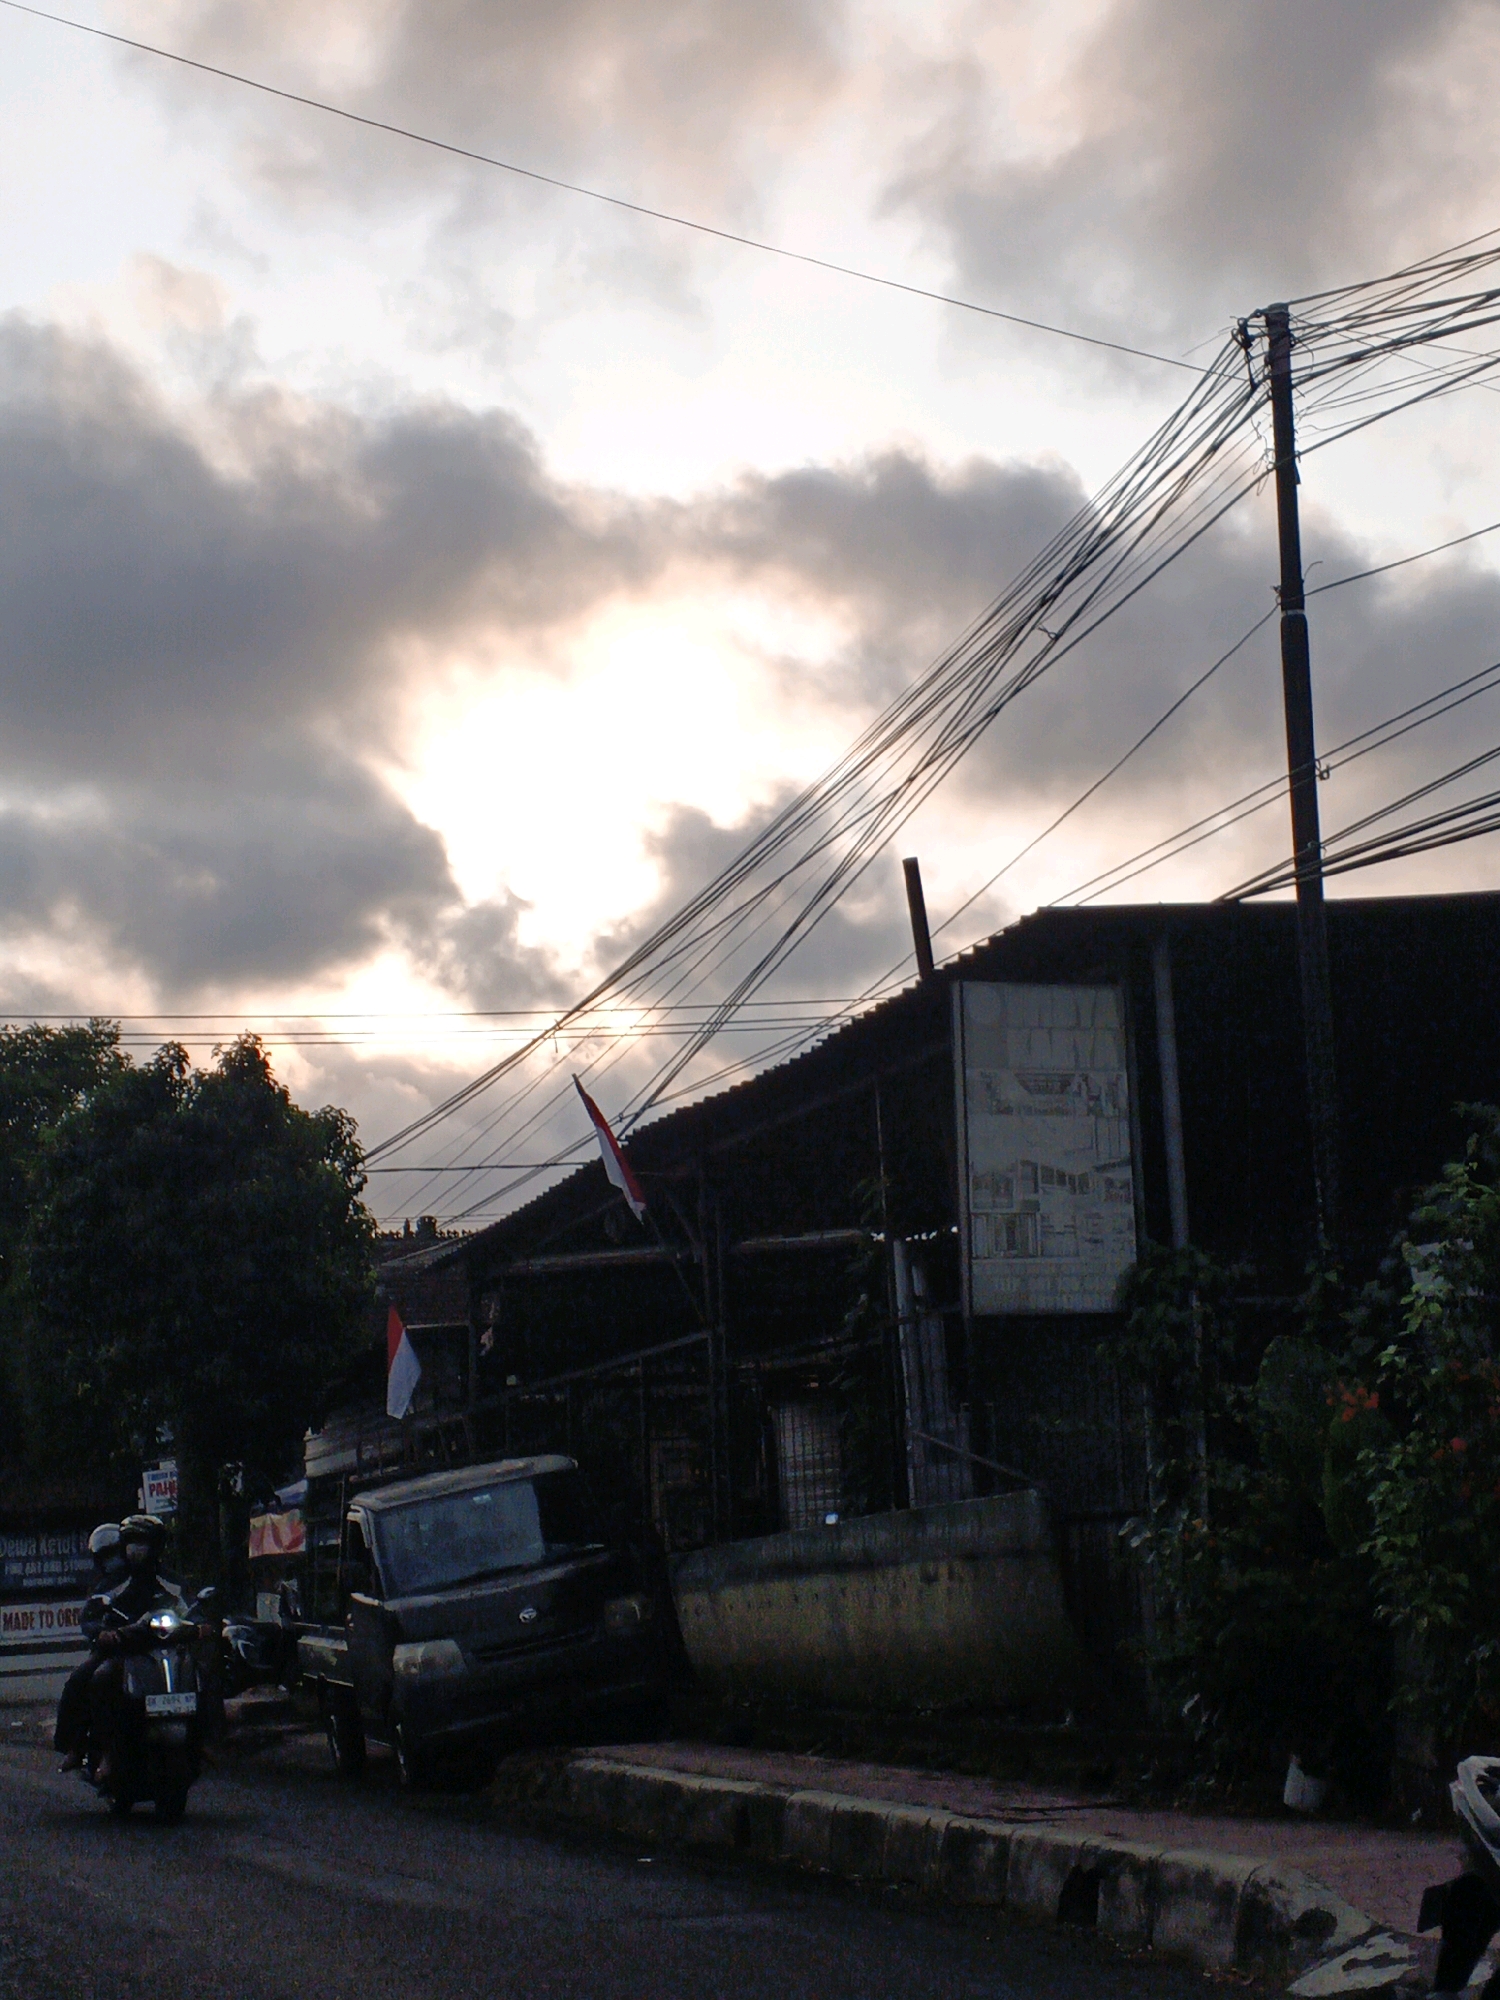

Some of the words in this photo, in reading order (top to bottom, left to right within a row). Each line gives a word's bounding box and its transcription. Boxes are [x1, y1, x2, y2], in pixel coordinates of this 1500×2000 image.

[3, 1611, 35, 1631] MADE
[38, 1609, 54, 1630] TO
[57, 1607, 82, 1628] ORD
